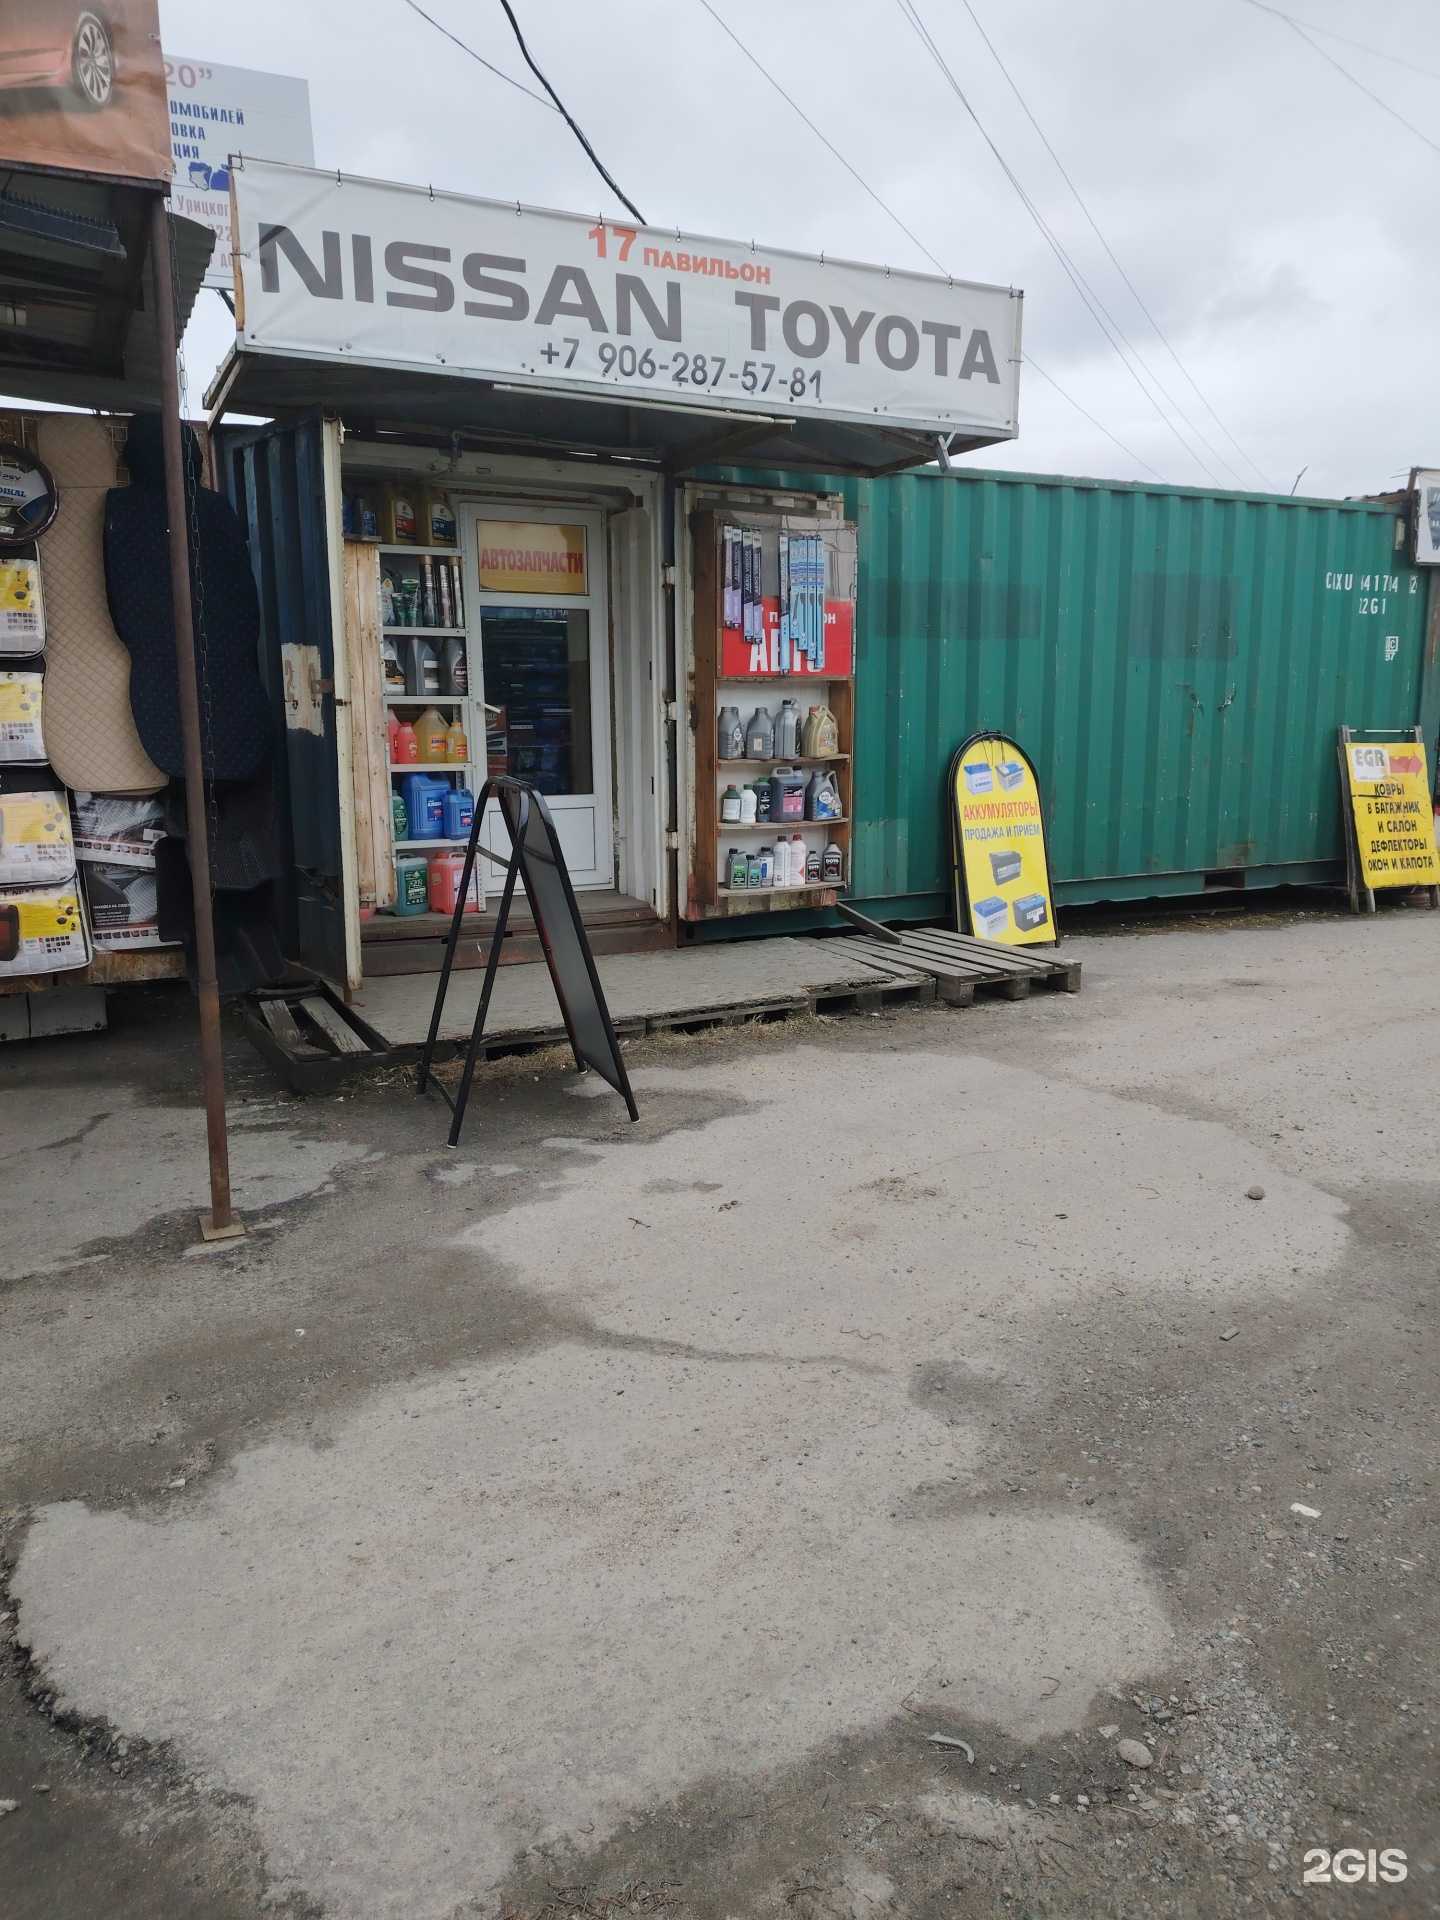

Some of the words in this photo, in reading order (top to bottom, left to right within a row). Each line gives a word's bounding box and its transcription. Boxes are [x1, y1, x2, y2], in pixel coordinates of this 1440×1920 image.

[588, 223, 637, 262] 17
[643, 247, 771, 285] ПАВИЛЬОН
[258, 222, 683, 342] NISSAN
[734, 294, 1002, 384] TOYOTA
[540, 337, 580, 369] +7
[598, 342, 821, 399] 906-287-57-81
[480, 548, 584, 574] АВТОЗАПЧАСТИ
[1355, 748, 1385, 767] EGR
[1373, 783, 1405, 796] КОВРЫ
[963, 800, 1039, 821] АККУМУЛЯТОРЫ
[1375, 801, 1420, 814] БАГАЖНИК
[965, 826, 1005, 841] ПРОДАЖА
[1006, 825, 1012, 837] И
[1377, 821, 1384, 833] И
[1387, 819, 1417, 833] САЛОН
[1371, 838, 1427, 854] ДЕФЛЕКТОРЫ
[1368, 858, 1389, 871] ОКОН
[1391, 858, 1398, 870] И
[1400, 855, 1434, 870] КАПОТА
